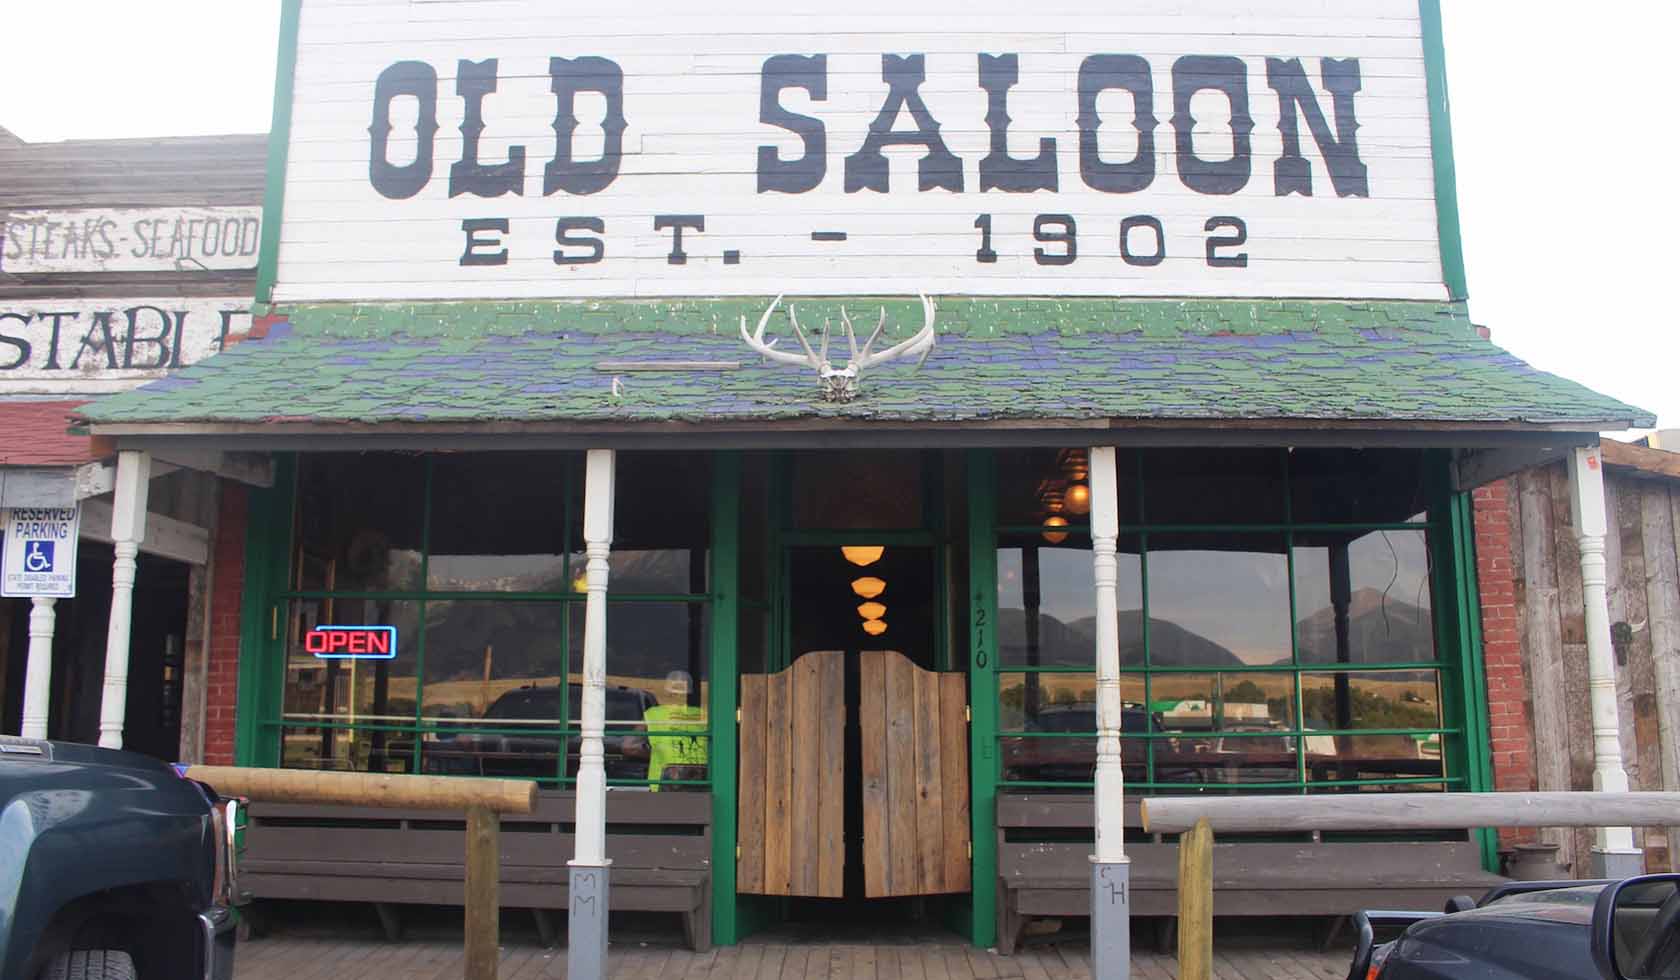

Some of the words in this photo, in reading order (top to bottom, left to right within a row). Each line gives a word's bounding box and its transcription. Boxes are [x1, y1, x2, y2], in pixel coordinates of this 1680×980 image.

[369, 56, 628, 199] OLD
[757, 53, 1369, 199] SALOON
[460, 215, 740, 266] EST.
[975, 214, 1248, 267] 1902
[13, 508, 75, 521] RESERVED
[16, 522, 68, 538] PARKING
[306, 631, 389, 653] OPEN
